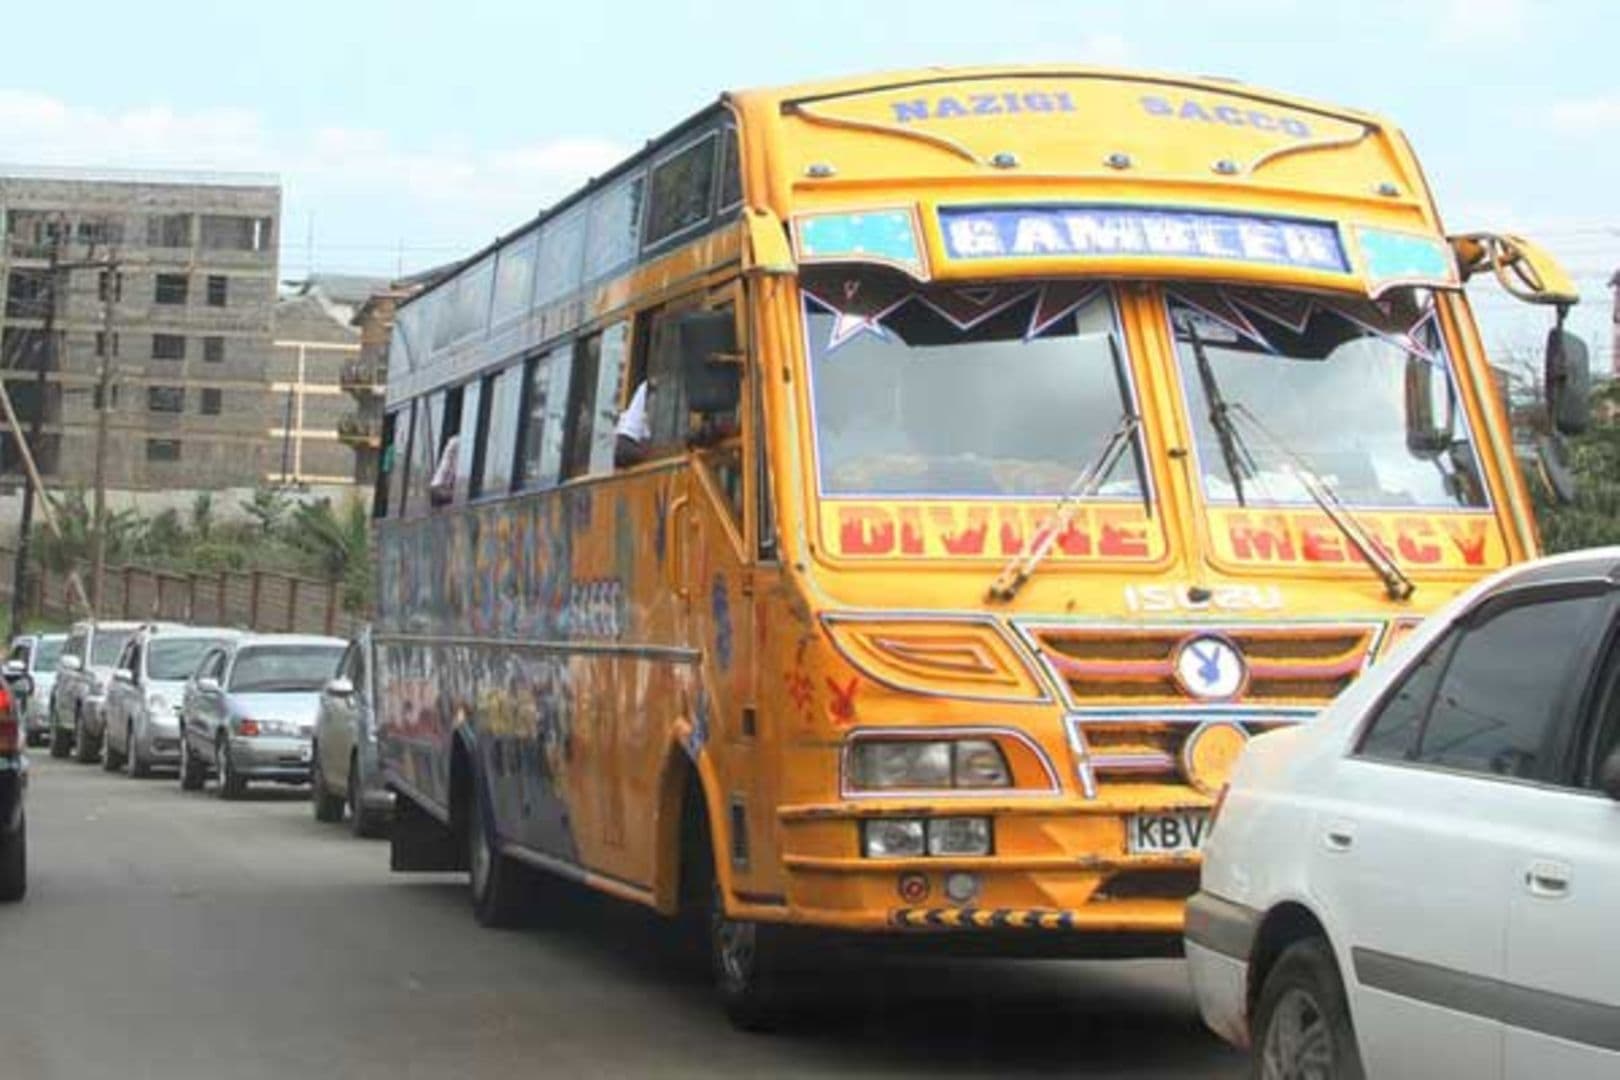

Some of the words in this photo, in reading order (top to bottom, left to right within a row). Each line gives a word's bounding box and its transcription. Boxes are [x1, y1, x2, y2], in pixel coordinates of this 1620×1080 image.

[891, 91, 1077, 122] NAZIGI
[1139, 95, 1310, 138] SACCO
[947, 212, 1336, 265] GAMBLER
[840, 504, 1149, 556] DIVINE
[1124, 584, 1282, 611] ISUZU
[1137, 816, 1203, 848] KBV
